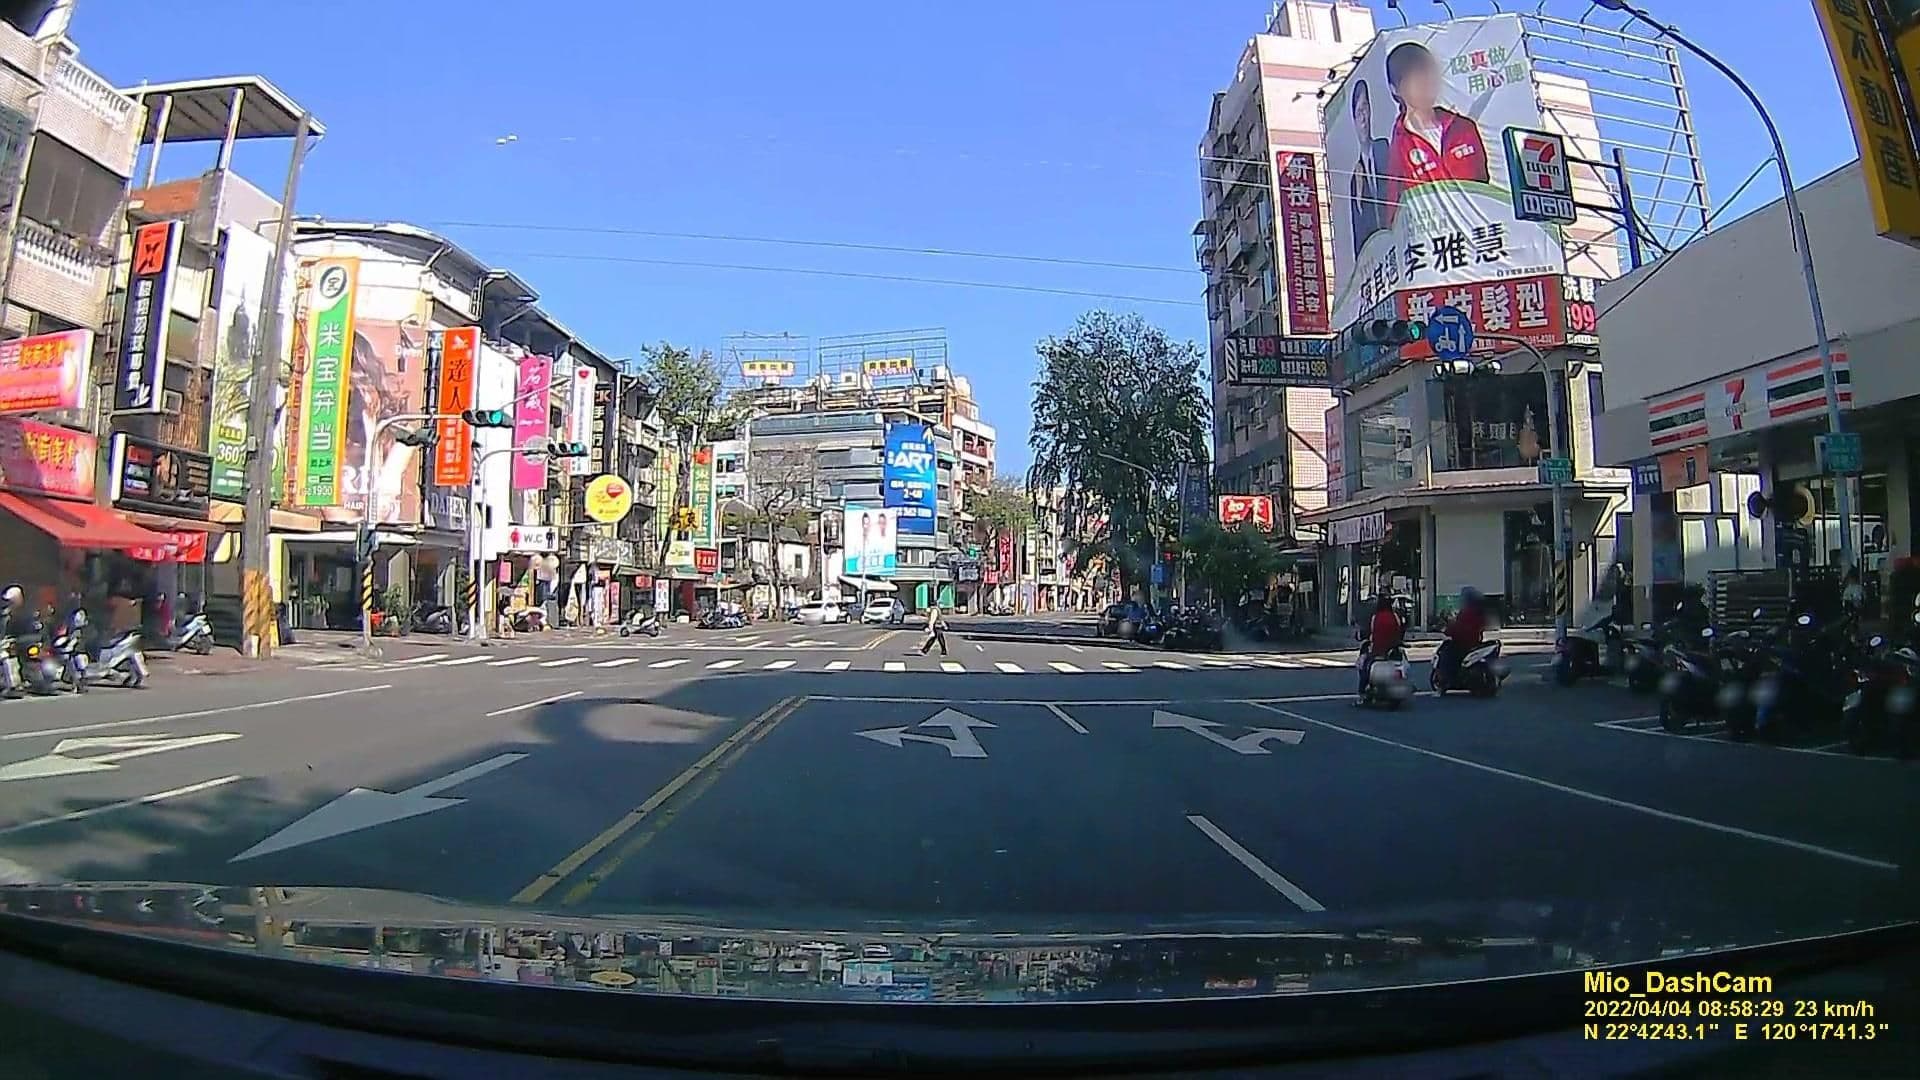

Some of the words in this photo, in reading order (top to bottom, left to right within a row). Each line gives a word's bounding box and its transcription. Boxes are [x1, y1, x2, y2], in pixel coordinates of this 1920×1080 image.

[1451, 46, 1506, 75] 認真做
[1286, 157, 1311, 207] 新技
[1523, 138, 1556, 189] 7
[1403, 221, 1510, 282] 李雅慧
[1571, 303, 1595, 332] 99
[311, 321, 341, 452] 米宝弁当
